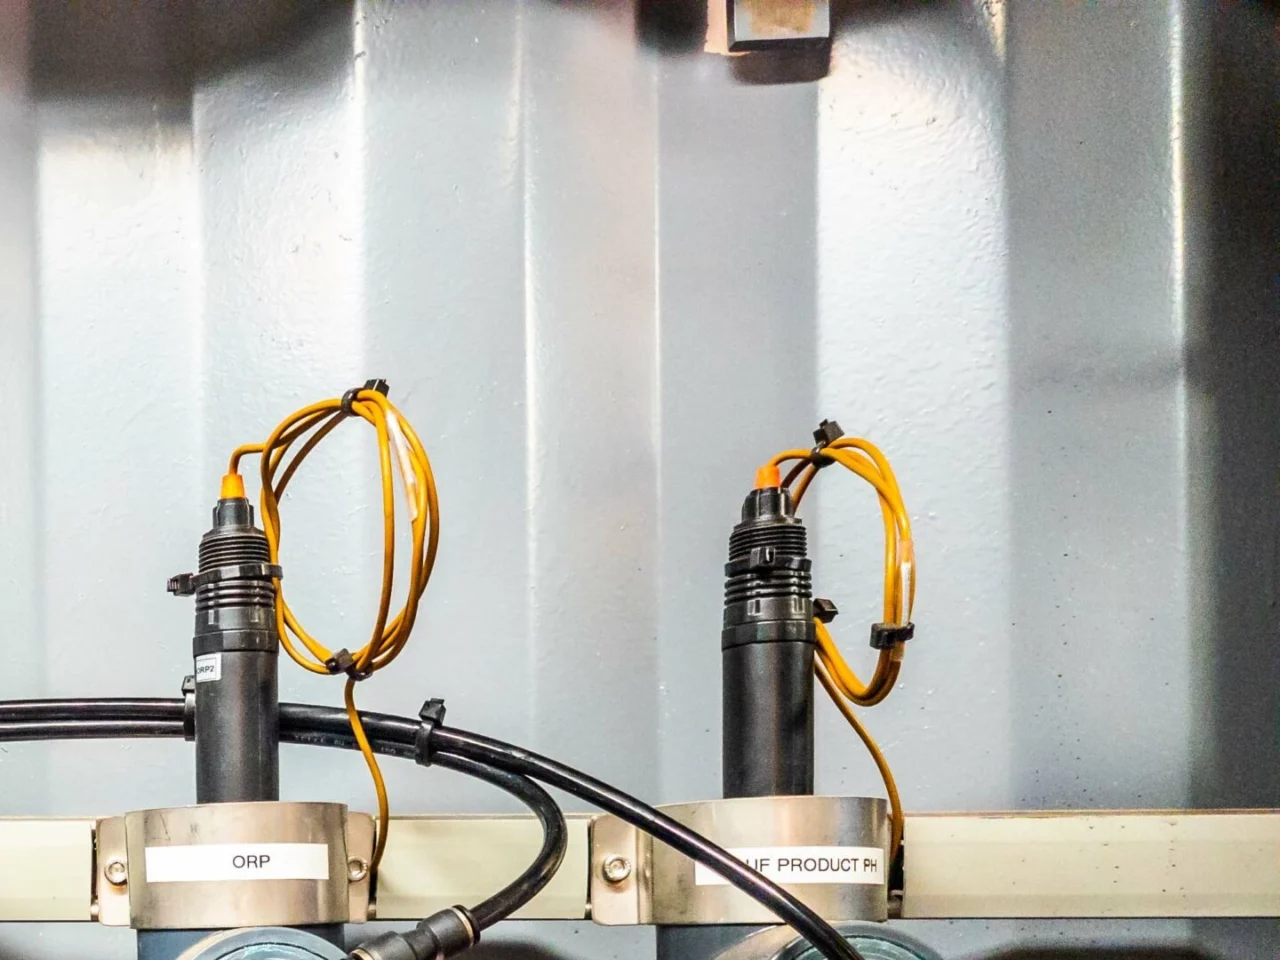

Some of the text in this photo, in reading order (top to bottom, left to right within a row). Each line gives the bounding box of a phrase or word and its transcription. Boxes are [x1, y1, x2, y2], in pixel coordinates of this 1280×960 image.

[232, 854, 271, 869] ORP
[777, 858, 860, 872] PRODUCT
[863, 858, 878, 873] PH
